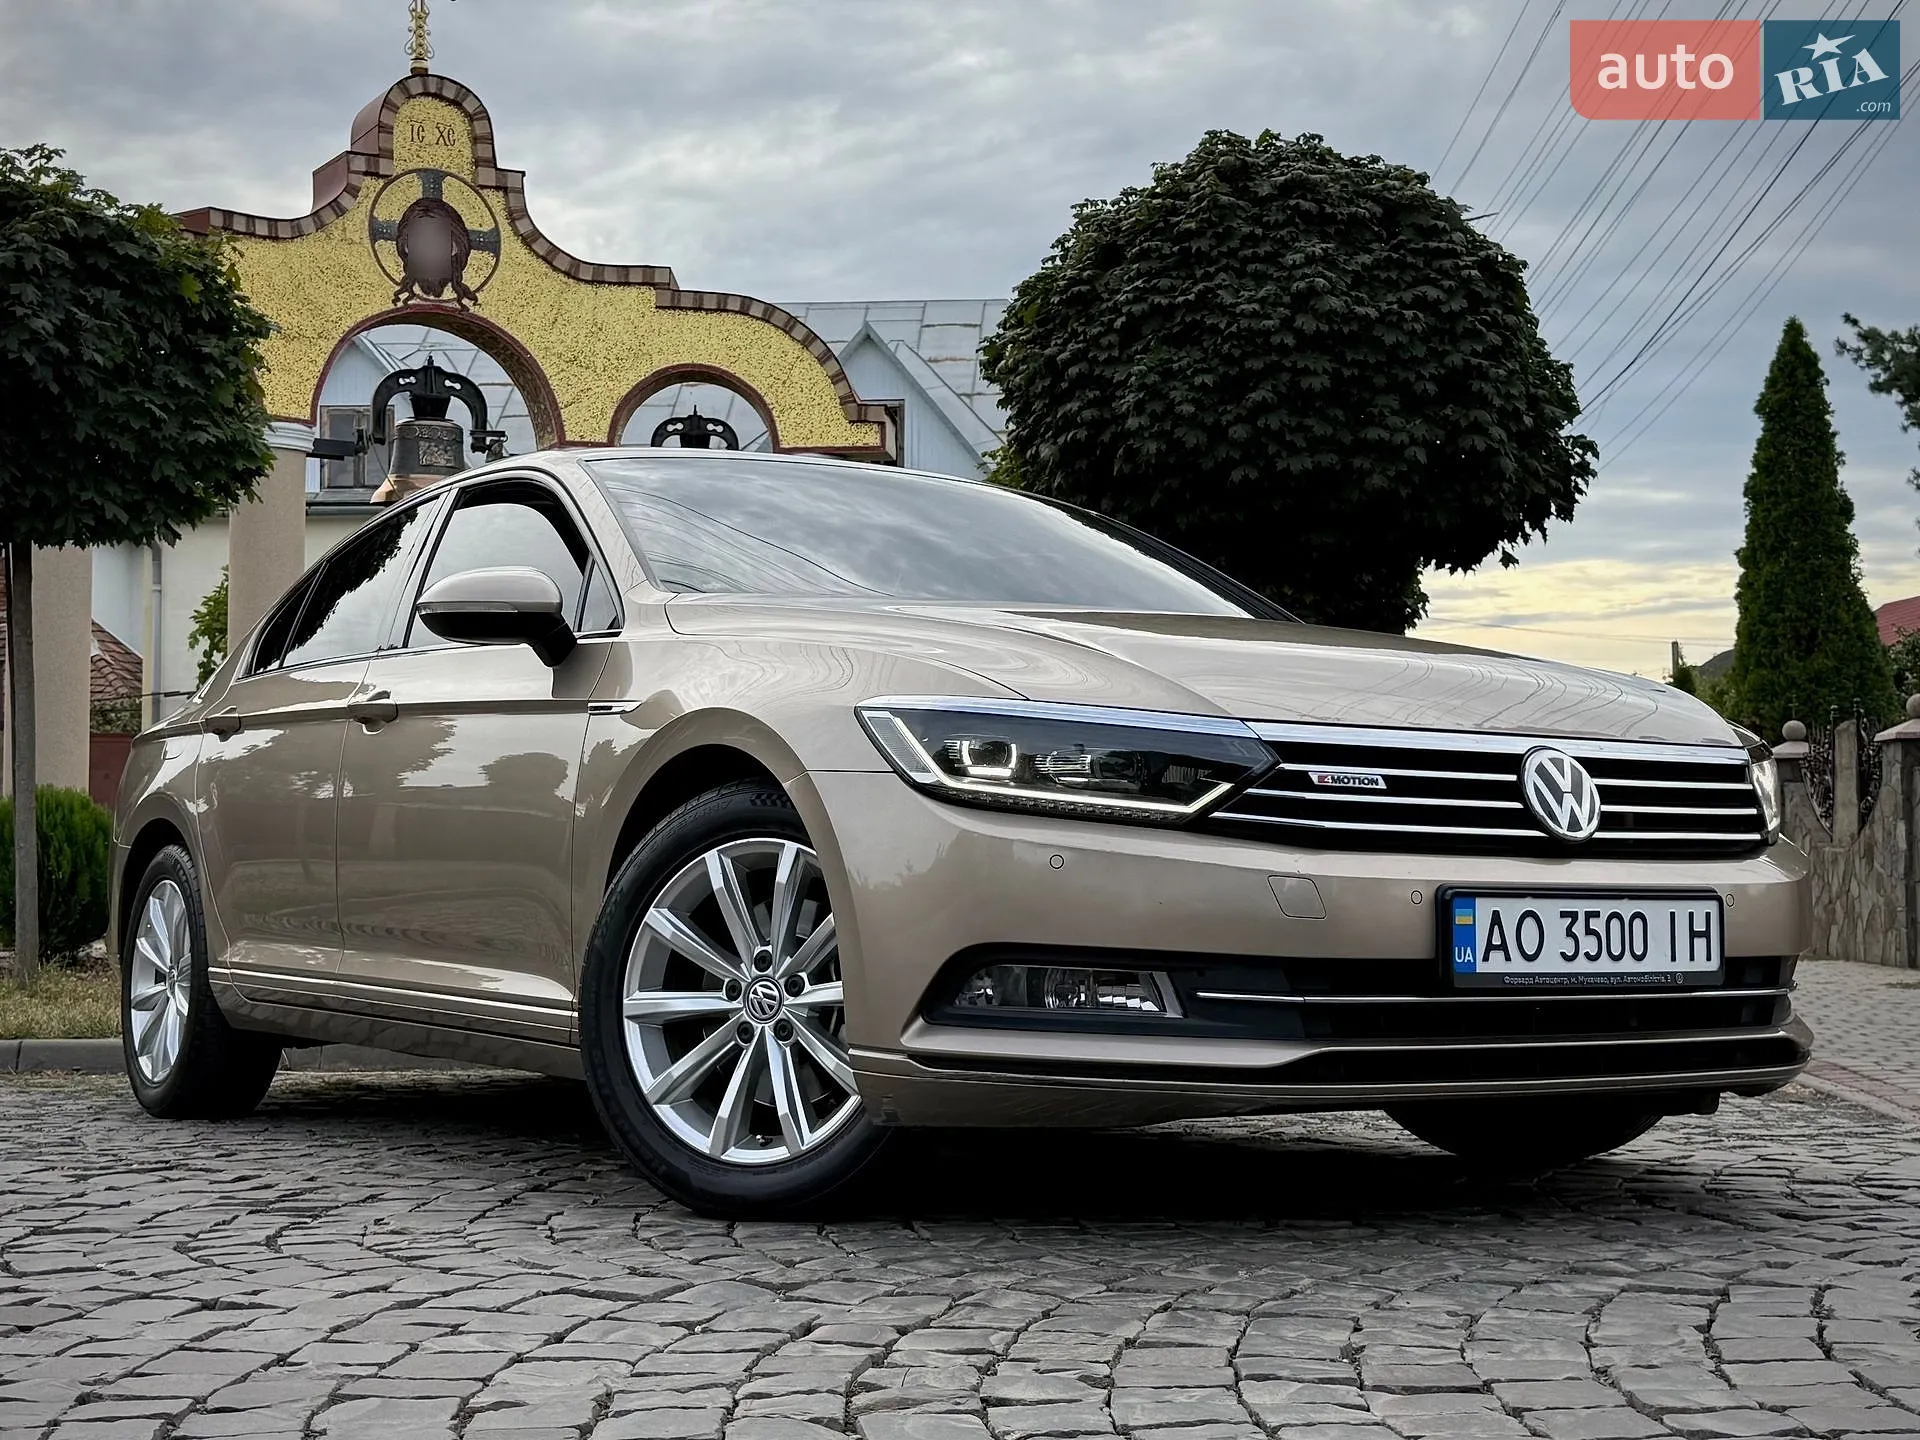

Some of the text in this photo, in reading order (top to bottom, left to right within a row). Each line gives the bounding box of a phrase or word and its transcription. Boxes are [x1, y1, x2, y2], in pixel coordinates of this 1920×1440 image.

[1323, 775, 1379, 786] 4MOTION
[1482, 909, 1713, 963] AO 3500 IH
[1455, 947, 1474, 963] UA
[1503, 975, 1534, 986] Форвард
